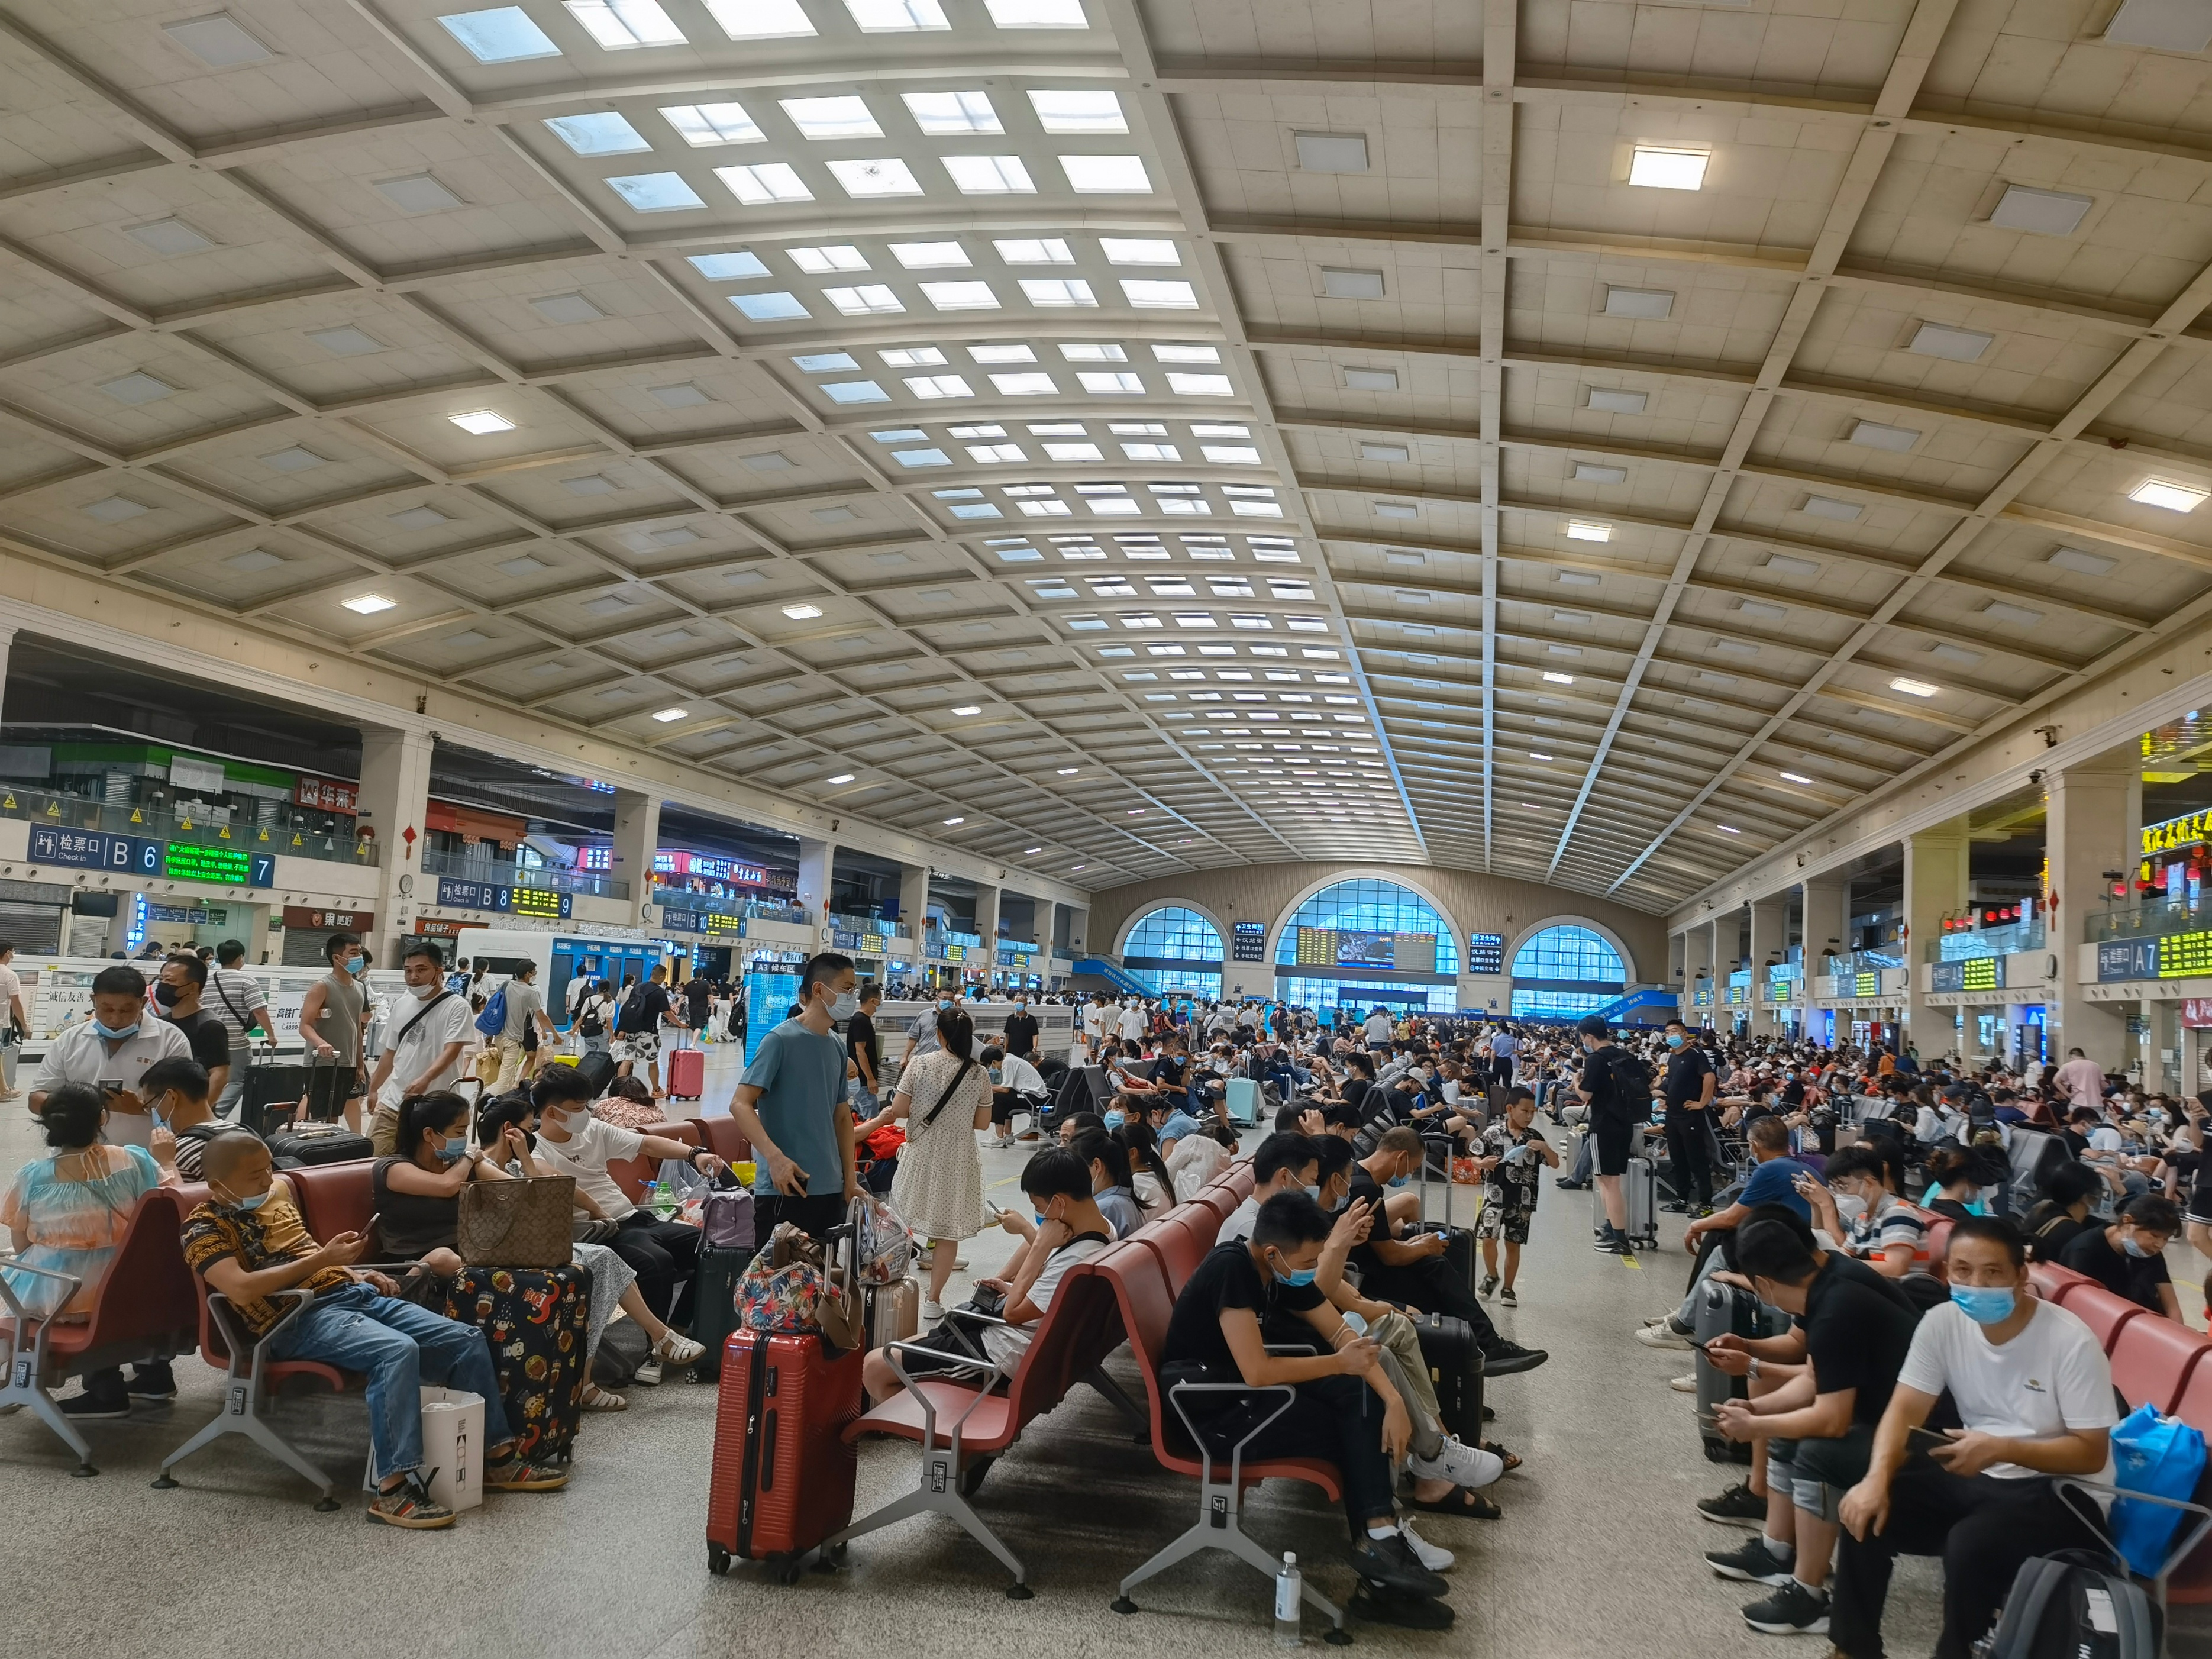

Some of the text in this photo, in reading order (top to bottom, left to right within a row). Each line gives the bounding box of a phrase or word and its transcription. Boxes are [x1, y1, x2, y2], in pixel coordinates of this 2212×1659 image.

[58, 852, 79, 861] Check
[60, 834, 156, 867] 检票口 B 6
[259, 860, 269, 880] 7
[454, 883, 476, 897] 检票口
[483, 887, 492, 905] B
[500, 890, 507, 906] 8
[563, 898, 569, 913] 9
[673, 912, 686, 922] 检票口
[690, 914, 696, 928] B
[699, 916, 707, 929] 10
[424, 922, 448, 933] 良品铺子
[740, 921, 745, 934] 11
[850, 935, 854, 946] B
[856, 936, 862, 947] 12
[882, 940, 887, 950] 13
[2135, 945, 2145, 971] A
[2147, 944, 2155, 970] 7
[771, 964, 795, 973] 候车区
[49, 990, 85, 1003] 诚信友善
